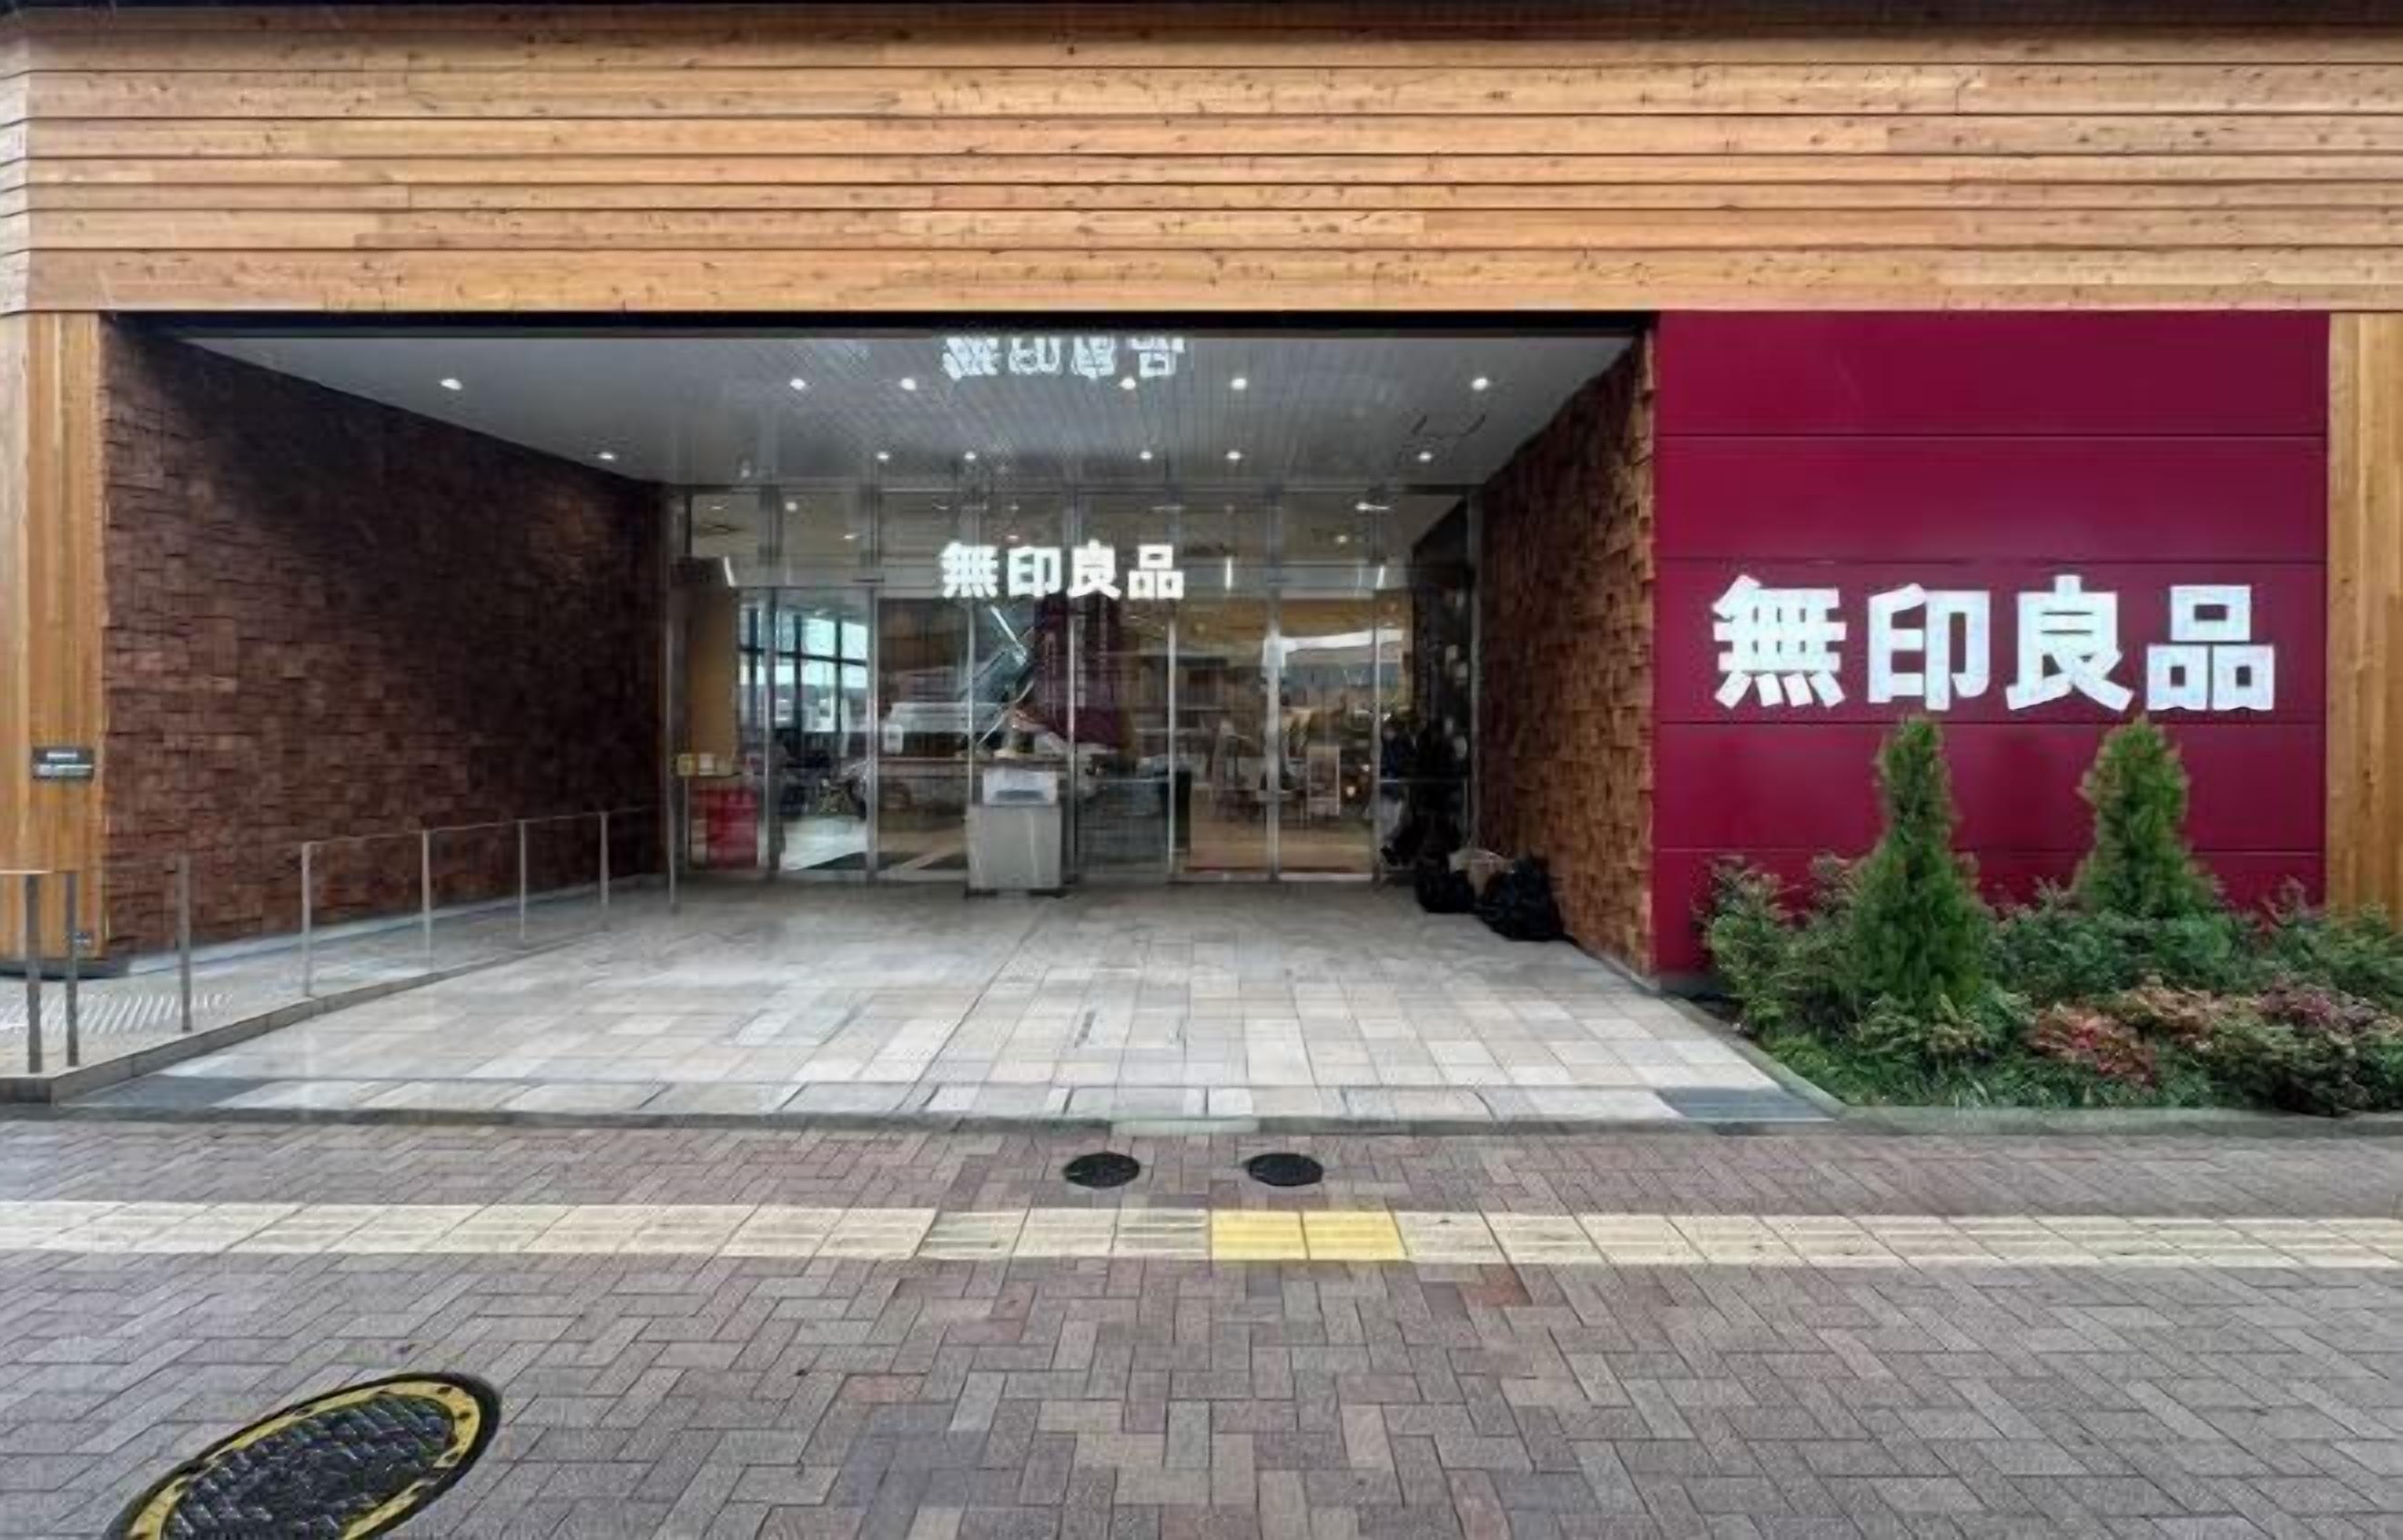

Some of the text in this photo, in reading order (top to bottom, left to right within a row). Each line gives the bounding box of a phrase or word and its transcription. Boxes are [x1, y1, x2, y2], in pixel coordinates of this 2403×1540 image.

[940, 540, 1184, 599] 無印良品
[1712, 574, 2275, 712] 無印良品
